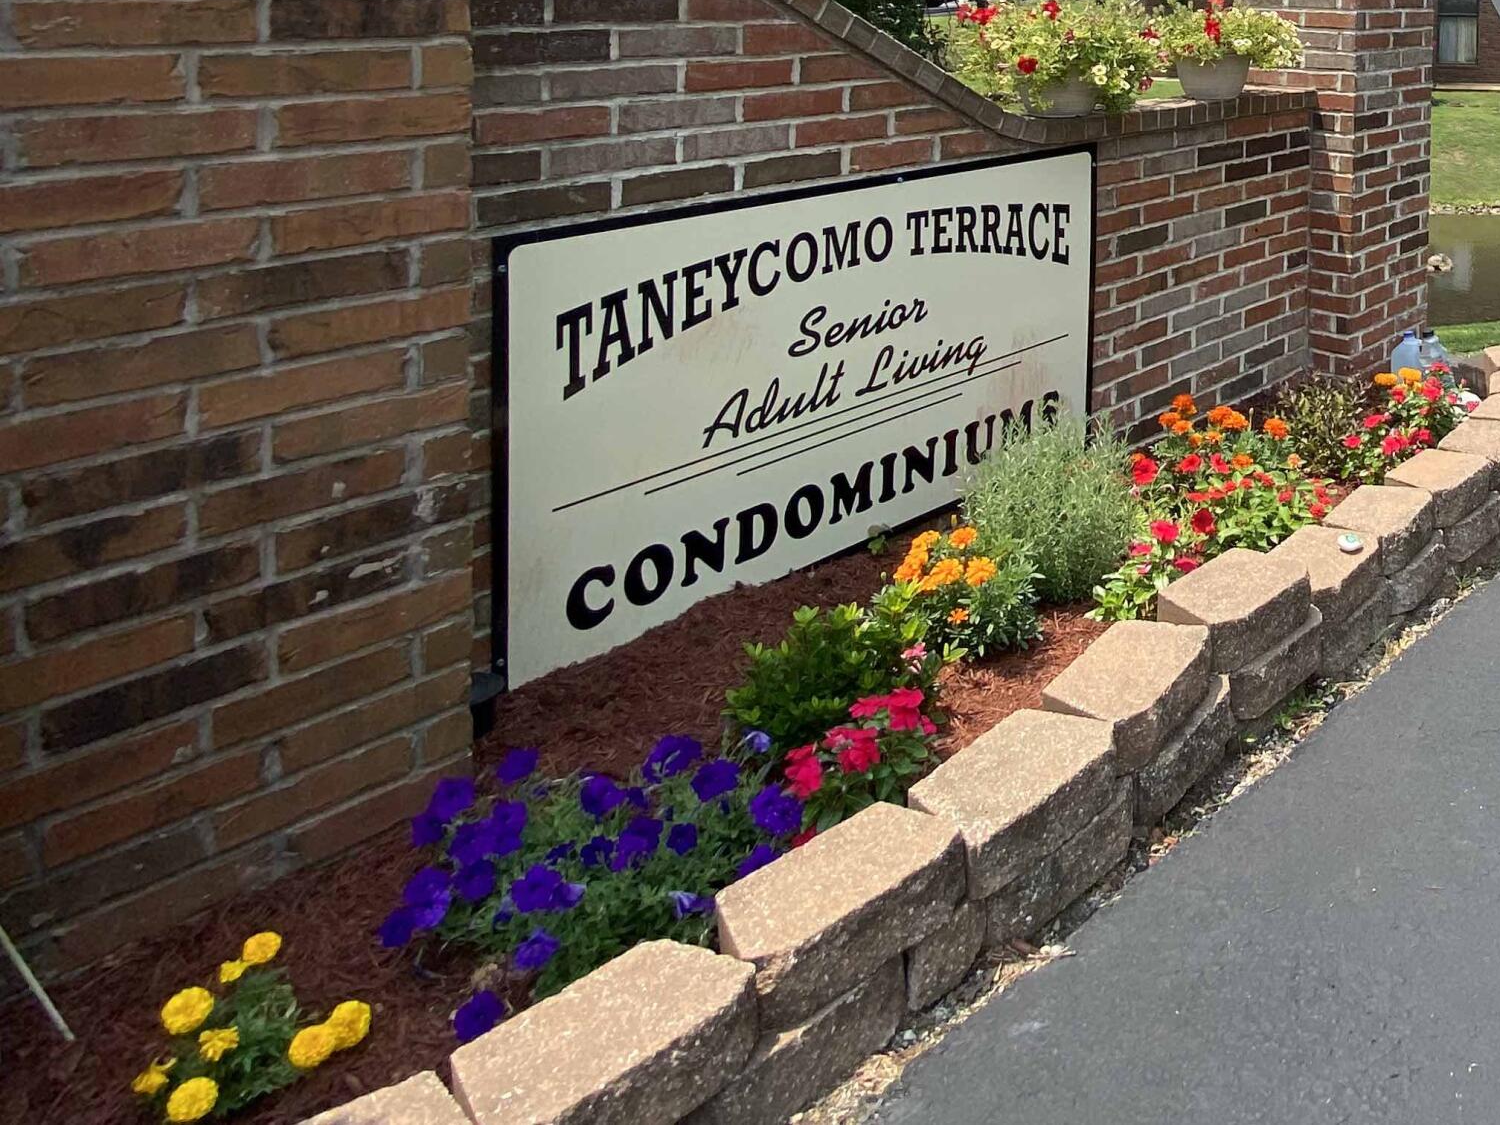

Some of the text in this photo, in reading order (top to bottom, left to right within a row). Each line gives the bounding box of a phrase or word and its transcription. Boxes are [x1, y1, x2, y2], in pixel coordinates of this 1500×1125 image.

[555, 202, 1071, 402] TANEYCOMO TERRACE
[787, 298, 929, 358] Senior
[702, 335, 988, 450] Adult Living
